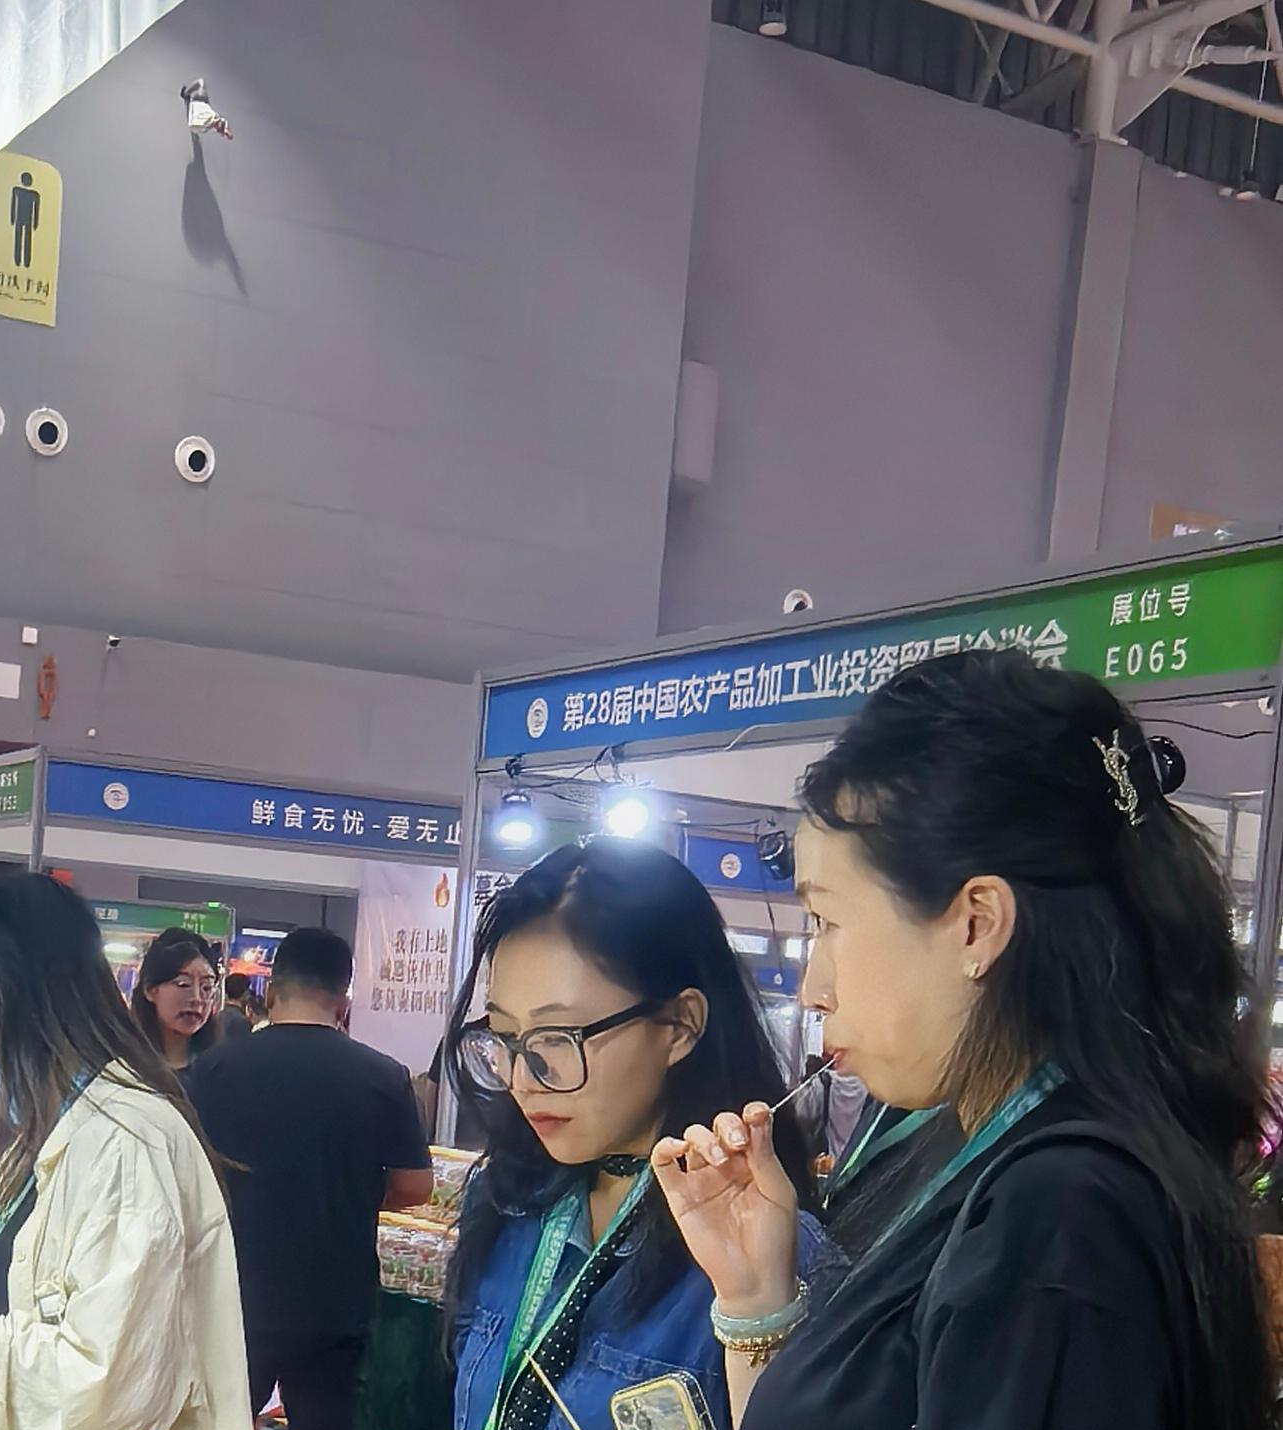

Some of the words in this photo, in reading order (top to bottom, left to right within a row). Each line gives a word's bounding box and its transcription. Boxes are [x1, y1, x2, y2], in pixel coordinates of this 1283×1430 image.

[1109, 583, 1191, 626] 展位号
[1105, 637, 1189, 678] E065
